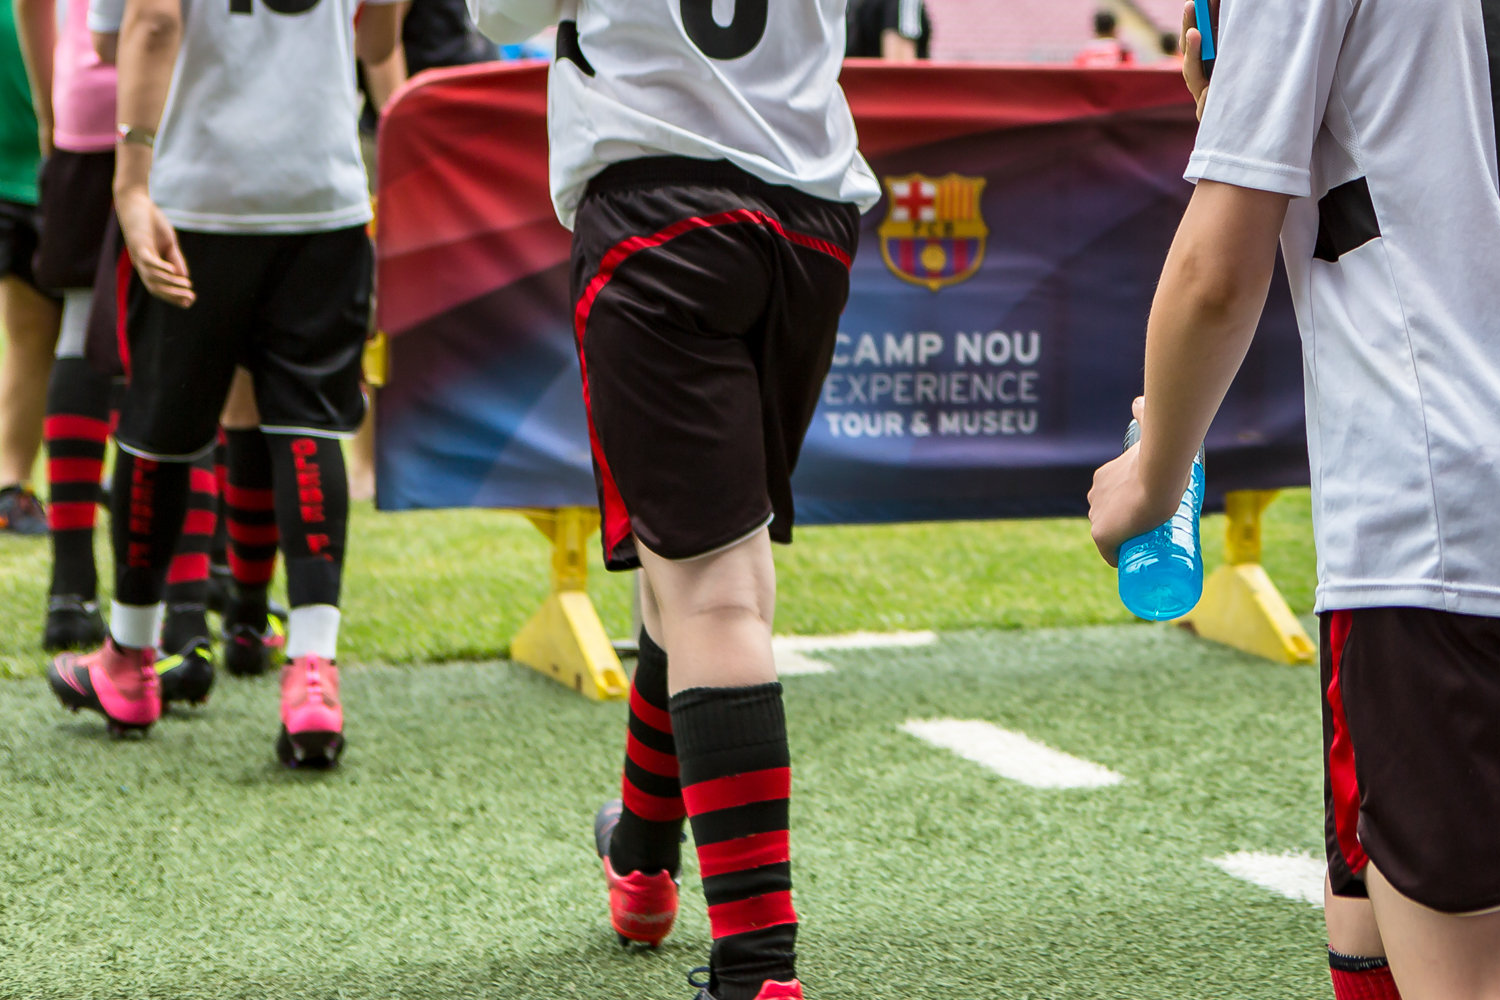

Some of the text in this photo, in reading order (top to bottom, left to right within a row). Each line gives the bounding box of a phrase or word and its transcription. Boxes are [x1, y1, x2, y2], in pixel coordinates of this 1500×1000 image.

[832, 331, 1041, 367] CAMP NOU
[823, 371, 1039, 406] EXPERIENCE
[824, 409, 1038, 438] TOUR & MUSEU
